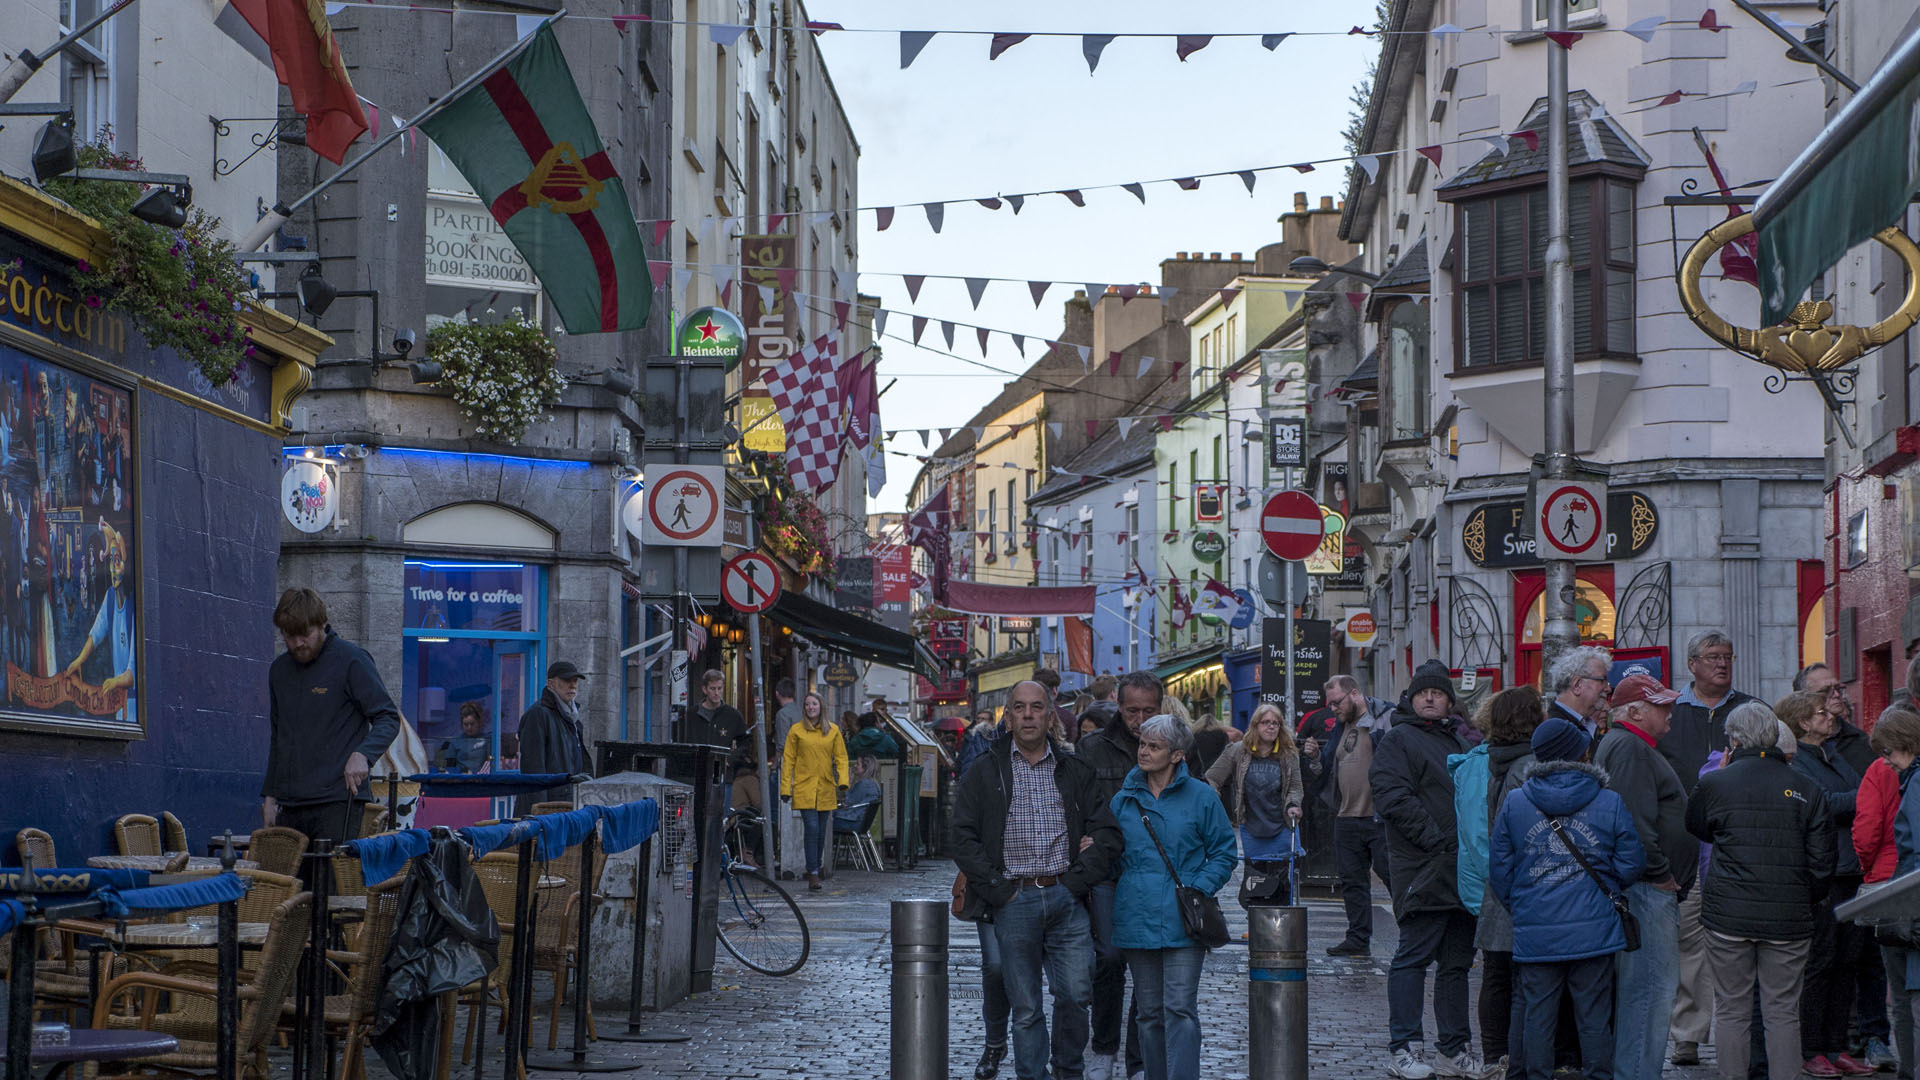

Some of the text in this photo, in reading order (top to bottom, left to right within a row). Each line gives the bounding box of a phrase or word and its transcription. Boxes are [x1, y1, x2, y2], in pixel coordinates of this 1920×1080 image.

[432, 207, 504, 234] PARTIE
[470, 233, 479, 243] &
[682, 346, 738, 357] Heineken
[744, 402, 766, 417] The
[1195, 540, 1222, 552] Carlsberg
[882, 572, 907, 583] SALE
[410, 586, 524, 604] Time for a coffee
[1002, 620, 1032, 629] BISTRO
[1274, 660, 1286, 668] THA
[1571, 819, 1600, 847] DREAM
